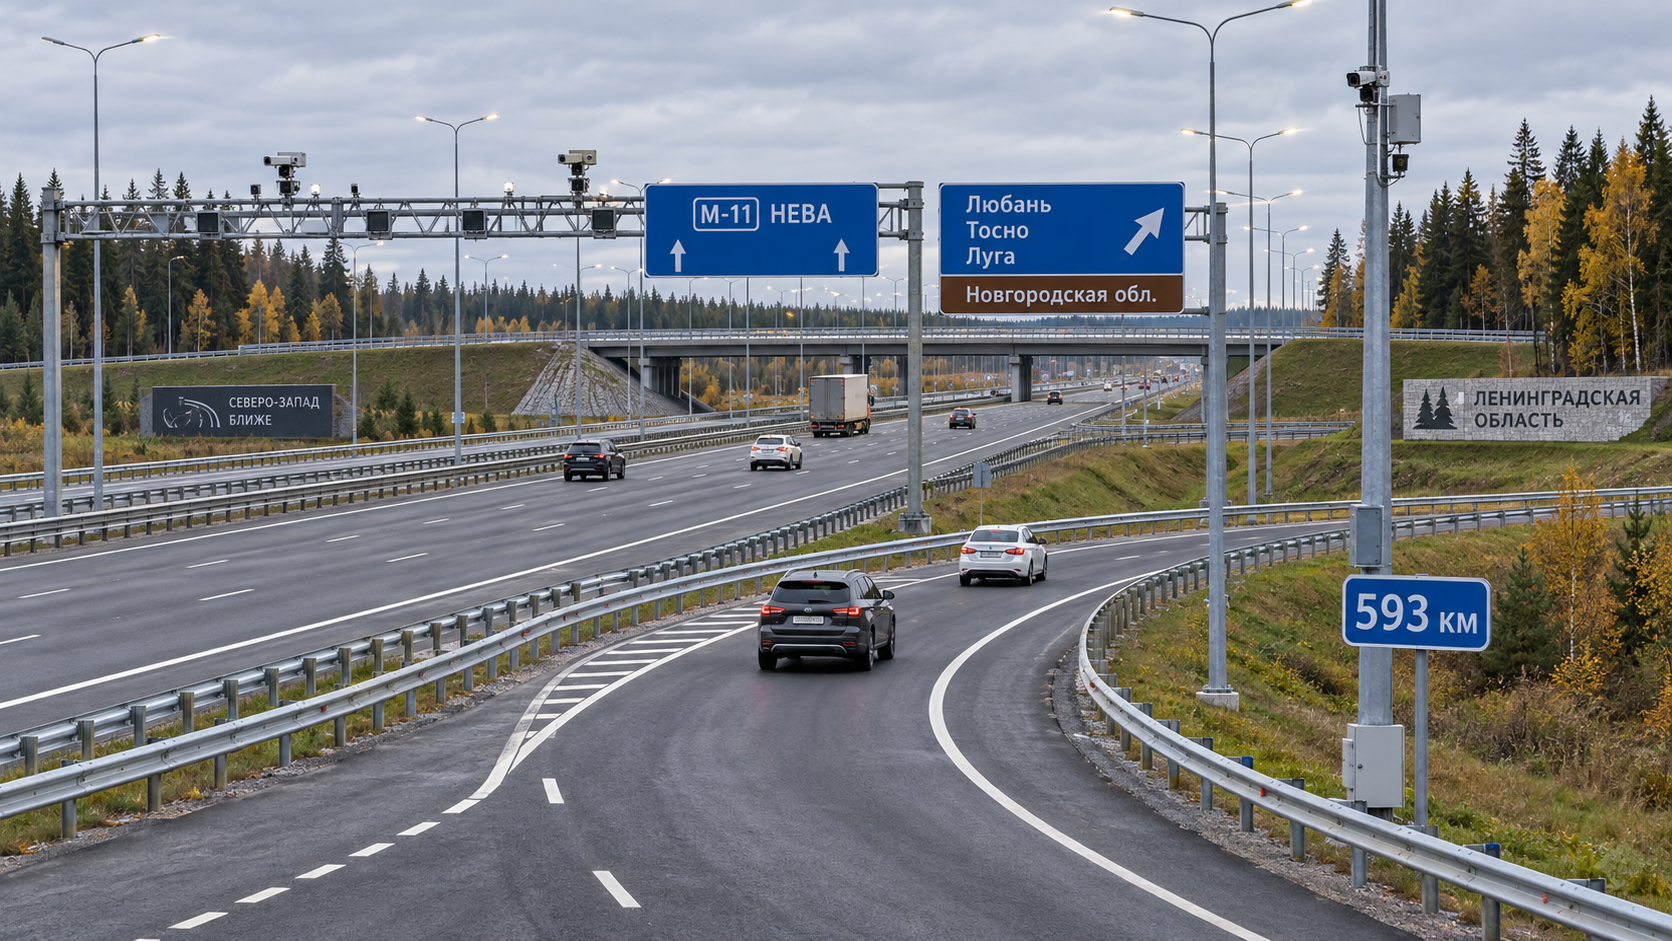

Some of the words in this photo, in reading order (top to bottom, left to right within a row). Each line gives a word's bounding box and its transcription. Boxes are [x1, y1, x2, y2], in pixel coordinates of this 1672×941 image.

[701, 204, 750, 224] М-11
[771, 203, 832, 224] НЕВА
[965, 194, 1052, 214] Любань
[965, 220, 1029, 239] Тосно
[965, 246, 1016, 269] Луга
[966, 285, 1107, 307] Новгородская
[1114, 284, 1157, 304] обл.
[228, 396, 321, 410] СЕВЕРО-ЗАПАД
[1473, 389, 1641, 409] ЛЕНИНГРАДСКАЯ
[229, 414, 272, 426] БЛИЖЕ
[1474, 412, 1564, 429] ОБЛАСТЬ
[1355, 592, 1430, 633] 593
